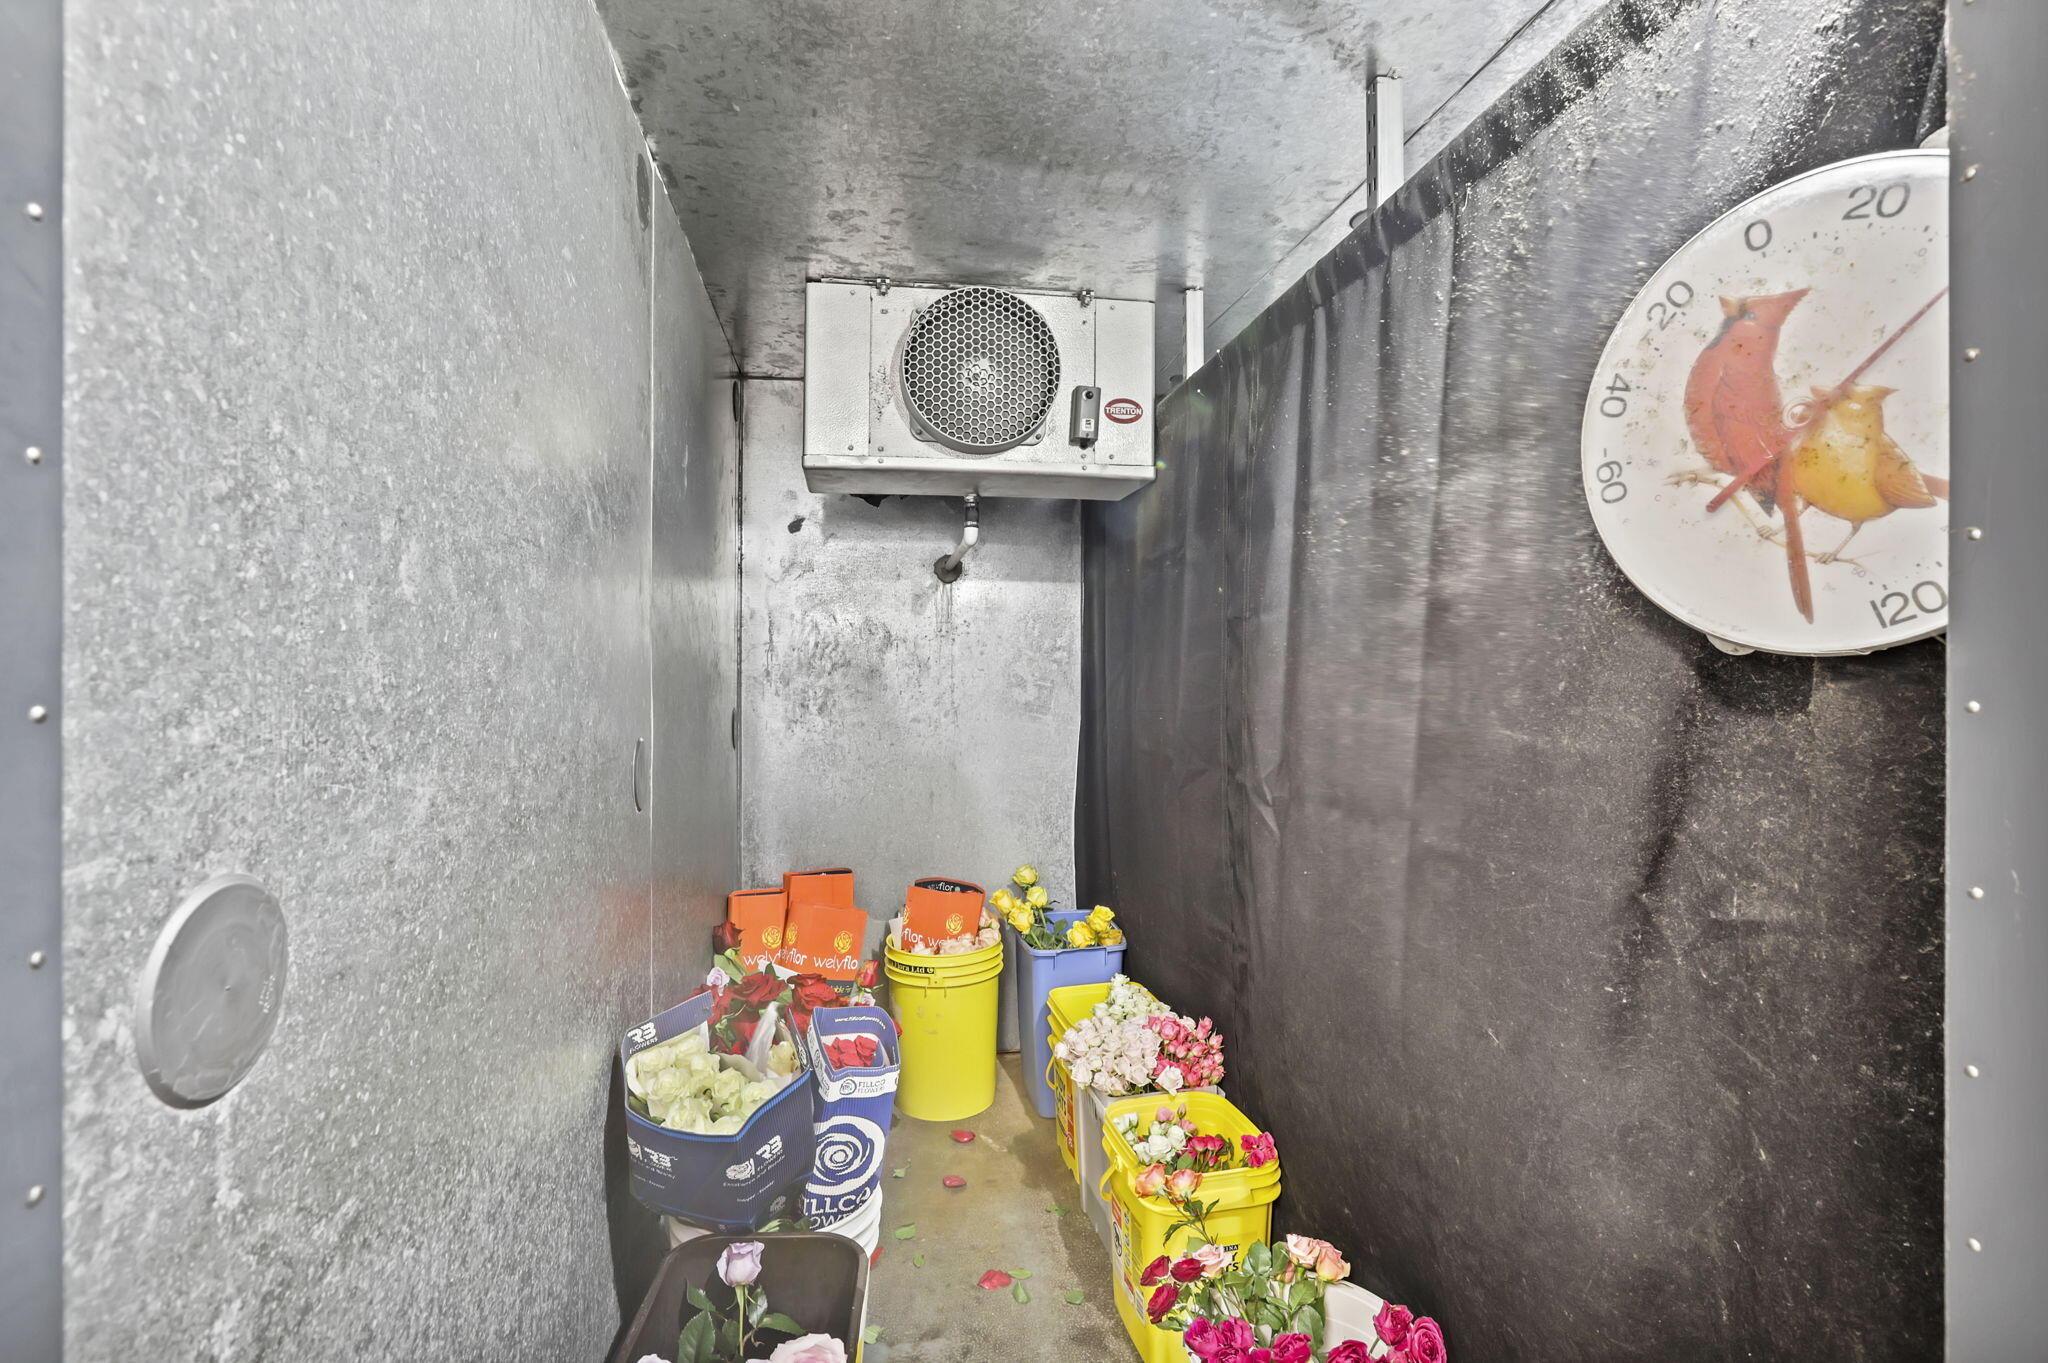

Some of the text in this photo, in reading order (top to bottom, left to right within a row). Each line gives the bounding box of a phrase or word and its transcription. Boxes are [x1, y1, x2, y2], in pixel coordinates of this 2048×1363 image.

[1842, 182, 1911, 221] 20
[1744, 219, 1773, 251] 0
[1105, 406, 1142, 415] TRENTON
[1869, 580, 1948, 629] 120
[858, 1079, 886, 1088] FILLCO
